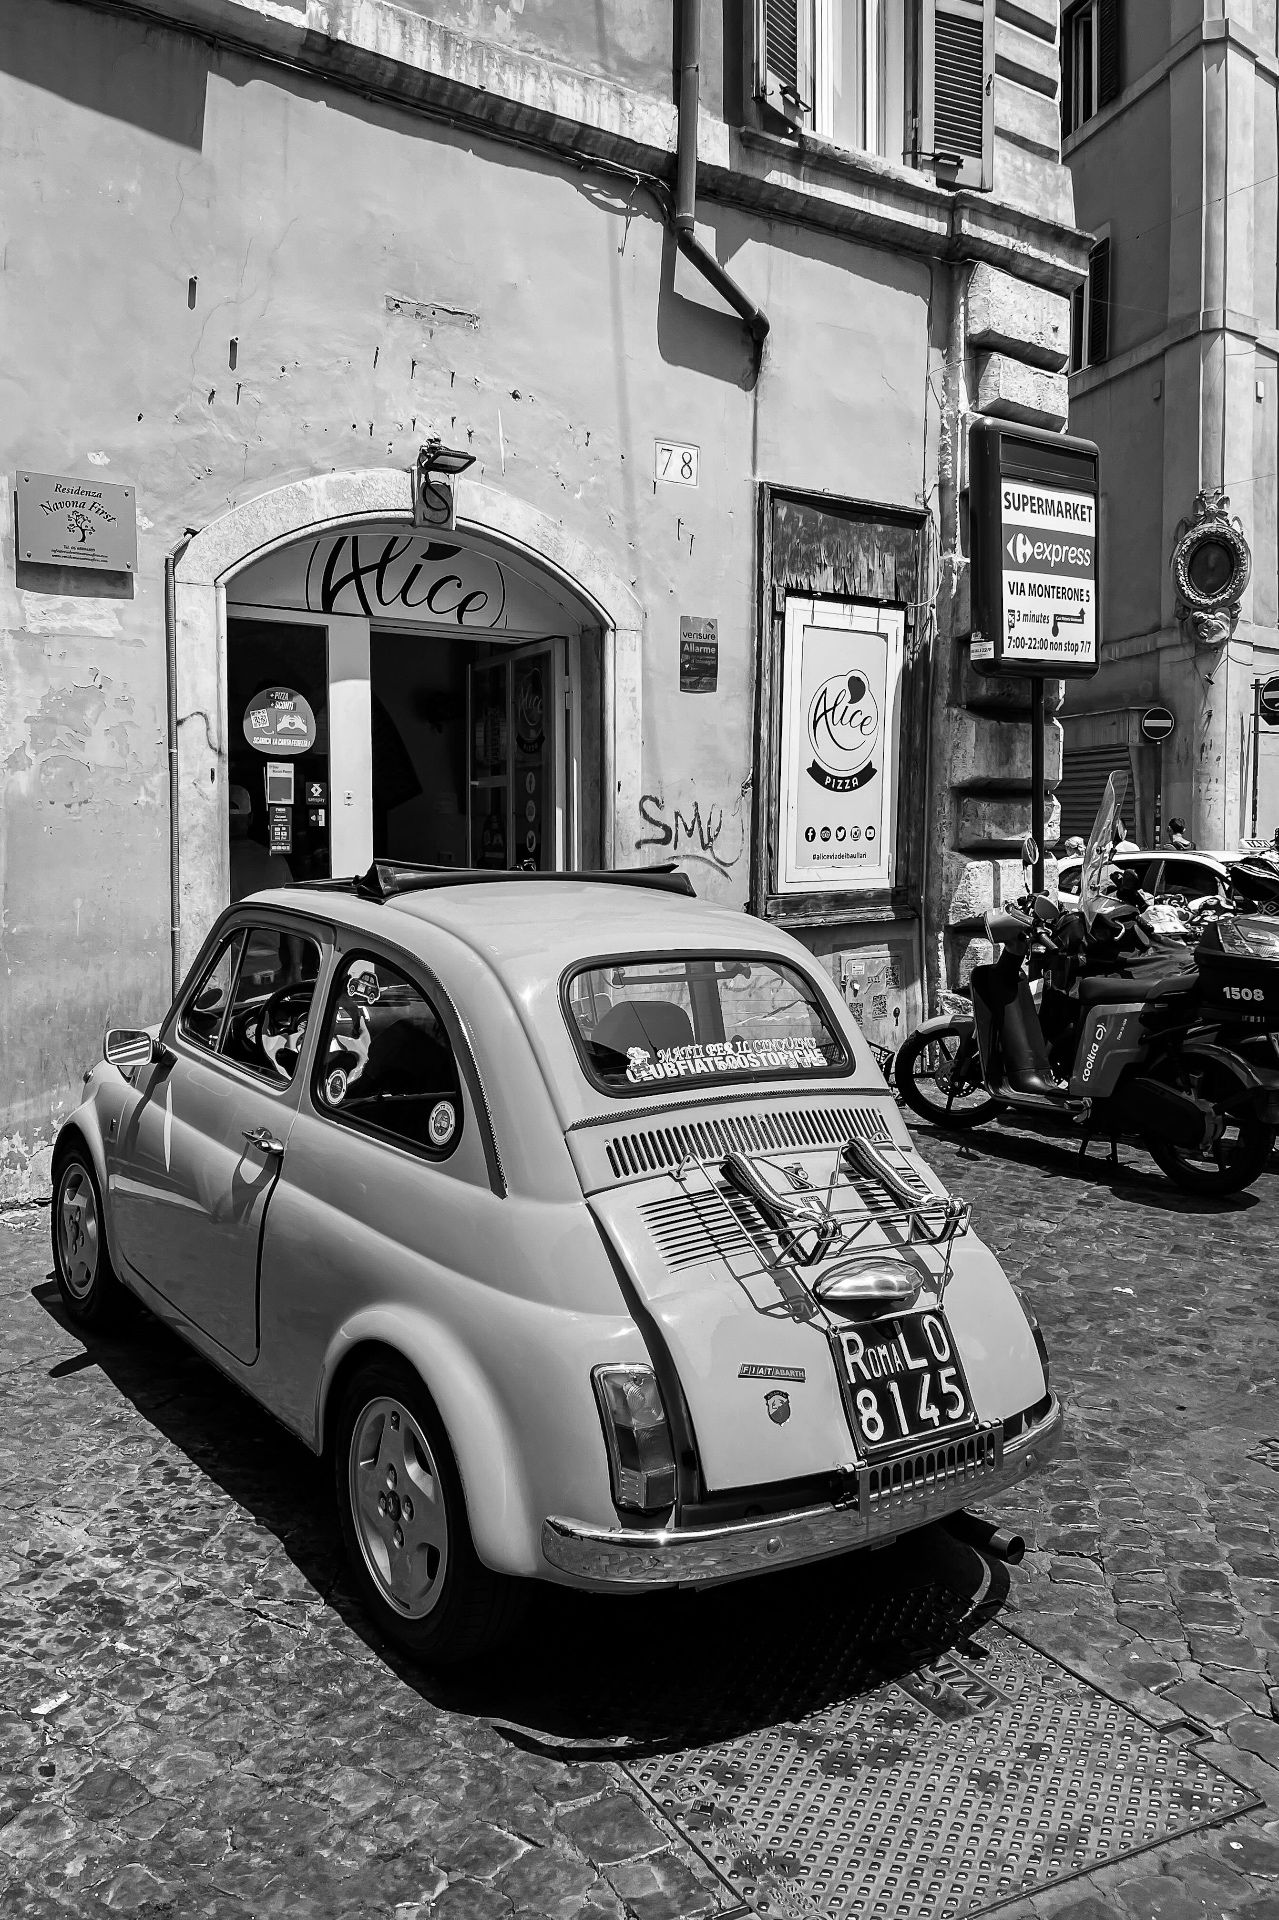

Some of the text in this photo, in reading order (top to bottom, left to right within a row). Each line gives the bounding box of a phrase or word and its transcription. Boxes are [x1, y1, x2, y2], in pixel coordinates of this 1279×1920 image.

[660, 447, 693, 480] 78
[54, 482, 103, 499] Residenza
[39, 500, 117, 523] Navona First
[1003, 491, 1093, 523] SUPERMARKET
[1033, 541, 1091, 568] express
[321, 535, 489, 625] Alice
[1007, 581, 1091, 603] VIA MONTERONE 5
[1016, 610, 1021, 623] 3
[1022, 610, 1050, 624] minutes
[682, 631, 716, 641] verisure
[1007, 635, 1049, 651] 7:00-22:00
[1049, 641, 1063, 652] non
[1063, 640, 1079, 656] stop
[1080, 640, 1092, 654] 7/7
[683, 642, 717, 654] Allarme
[274, 691, 289, 701] PIZZA
[812, 686, 873, 751] Alice
[824, 776, 859, 790] PIZZA
[1222, 986, 1265, 1002] 1508
[1082, 1042, 1099, 1082] cooltra
[742, 1366, 773, 1375] FIAT
[856, 1367, 965, 1442] 8145
[928, 1653, 999, 1711] WIN
